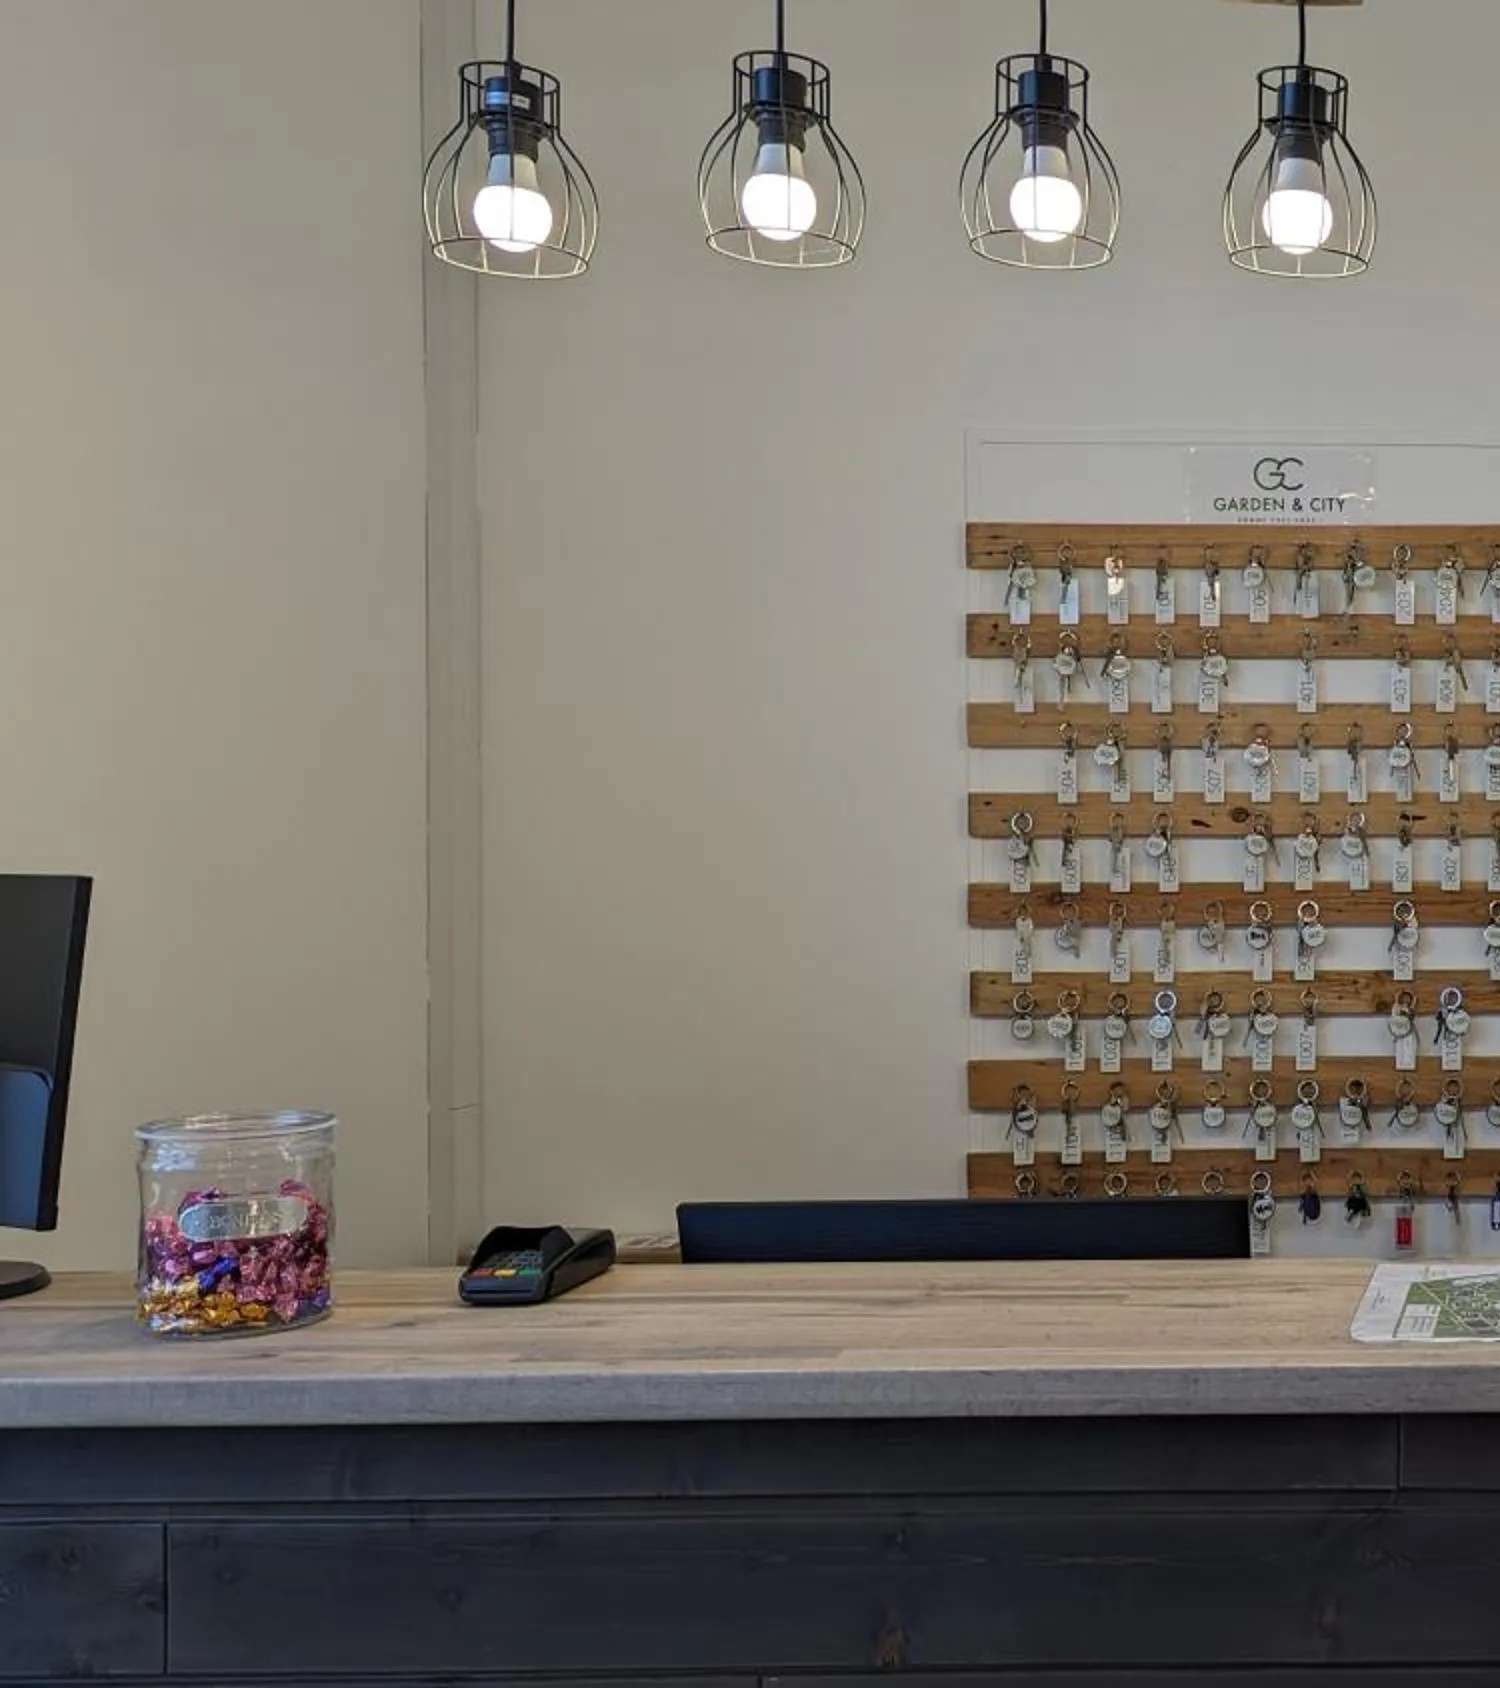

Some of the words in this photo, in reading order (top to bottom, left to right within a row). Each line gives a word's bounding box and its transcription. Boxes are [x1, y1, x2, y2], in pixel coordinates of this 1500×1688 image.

[1213, 497, 1285, 512] GARDEN
[1291, 497, 1303, 512] &
[1309, 497, 1346, 512] CITY
[1202, 681, 1214, 704] 301
[1300, 681, 1312, 704] 401
[1061, 771, 1074, 794] 504
[1207, 769, 1221, 794] 507
[1396, 861, 1408, 882] 801
[1444, 858, 1456, 881] 802
[1299, 1032, 1312, 1064] 1007
